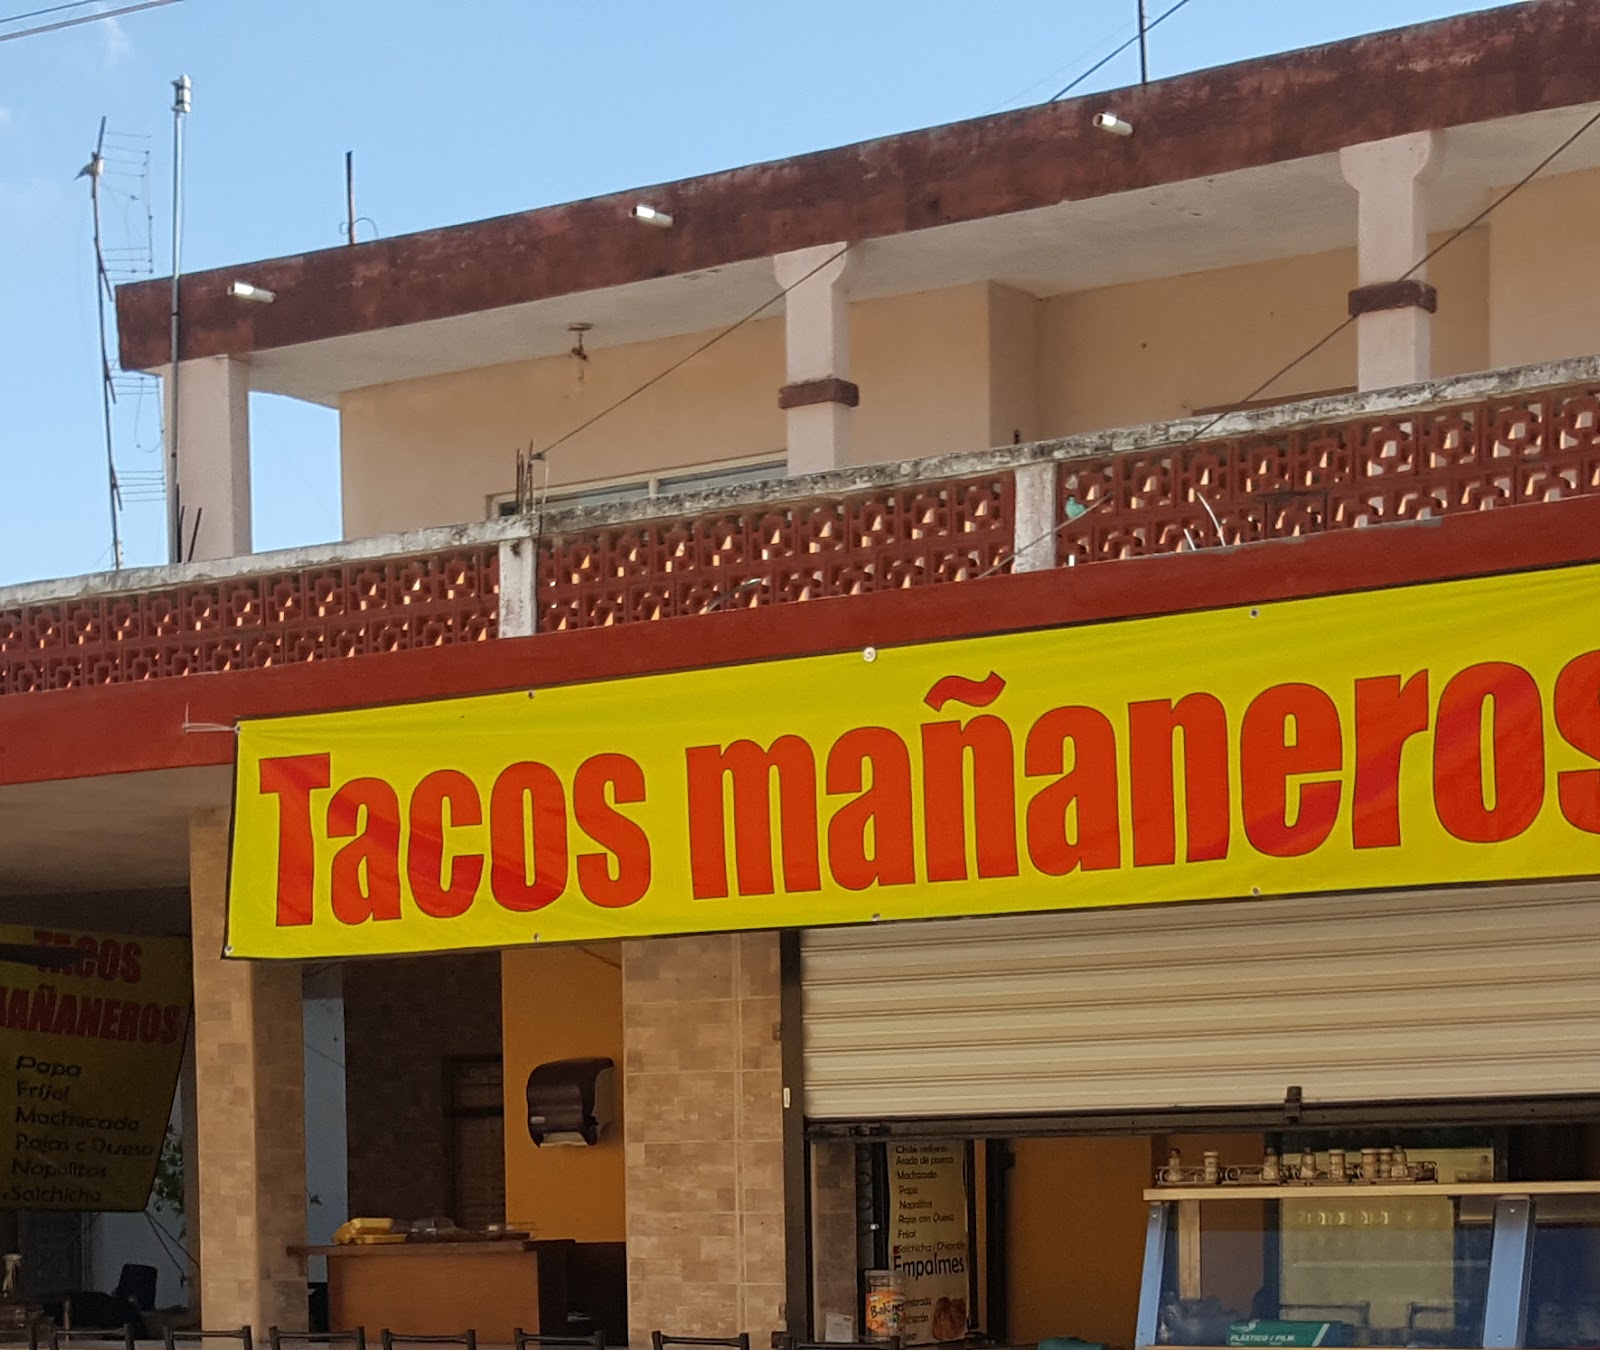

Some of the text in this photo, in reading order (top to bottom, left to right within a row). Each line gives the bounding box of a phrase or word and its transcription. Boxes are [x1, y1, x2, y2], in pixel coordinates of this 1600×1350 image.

[258, 752, 653, 927] Tacos
[16, 1055, 81, 1077] Papa
[16, 1081, 70, 1101] Frijol
[894, 1252, 964, 1280] Empalmes
